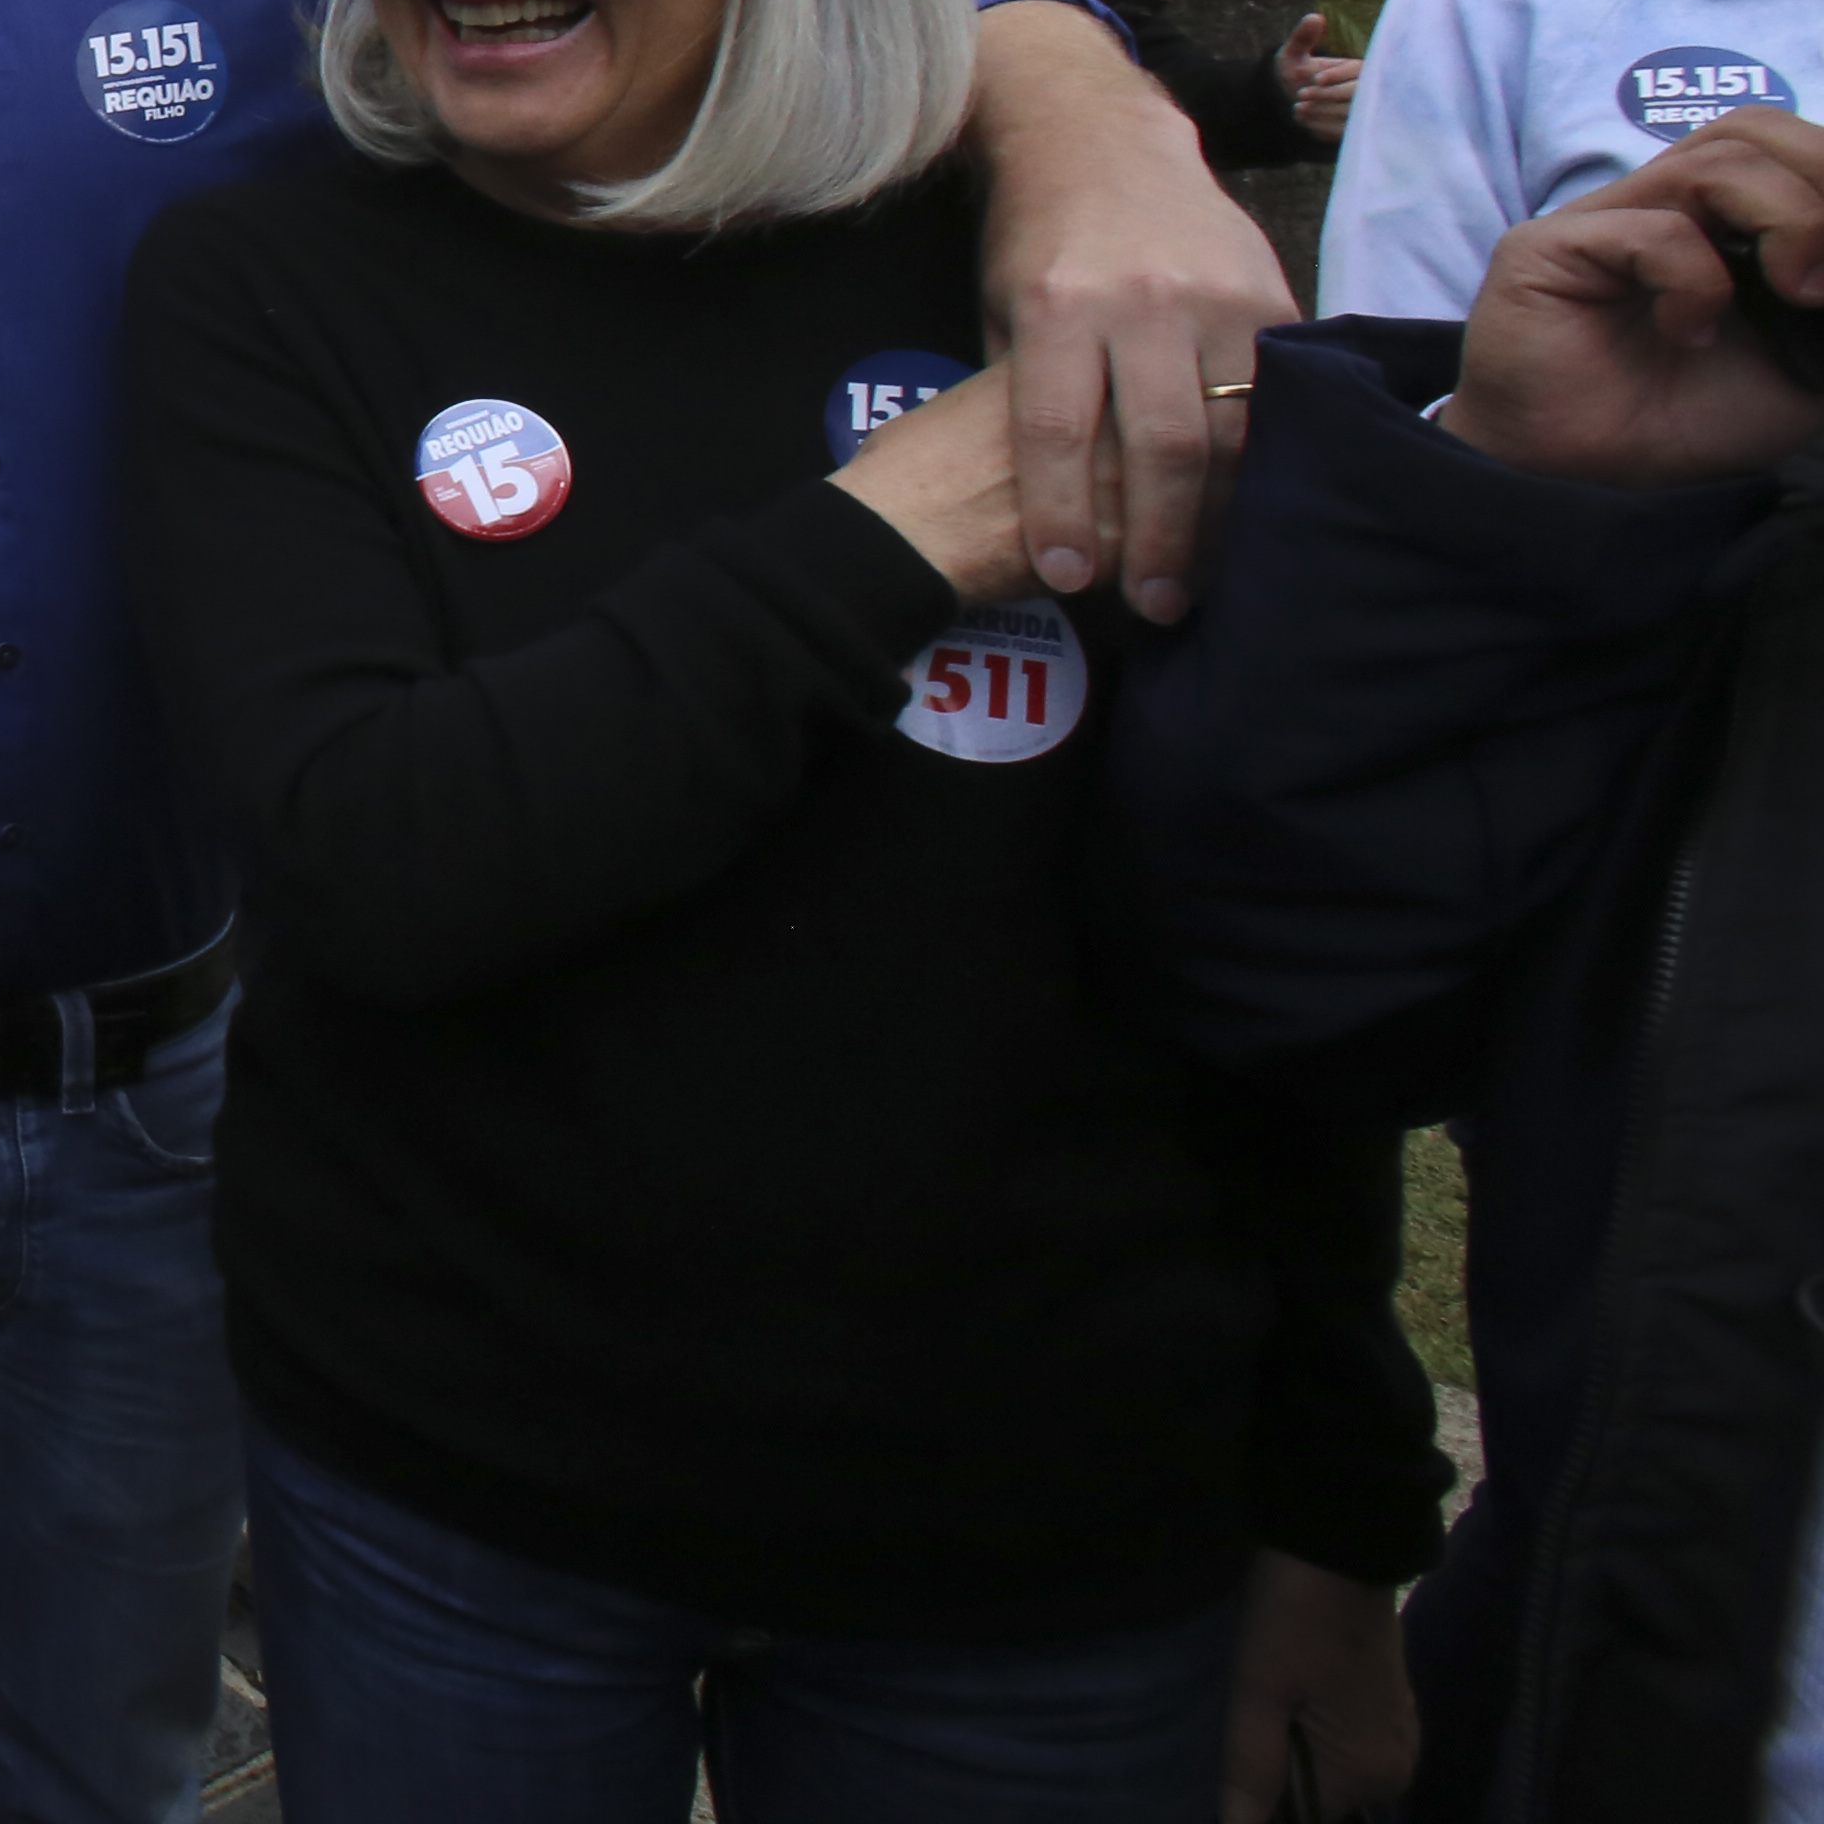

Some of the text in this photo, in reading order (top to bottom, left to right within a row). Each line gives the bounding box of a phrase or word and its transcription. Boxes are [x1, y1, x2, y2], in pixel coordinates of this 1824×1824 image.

[88, 21, 203, 78] 15.151
[1633, 65, 1768, 99] 15.151
[144, 104, 186, 122] FILHO
[1644, 106, 1739, 124] REQU
[447, 439, 540, 526] 15
[964, 606, 1062, 644] RRUDA
[921, 646, 1049, 726] 511
